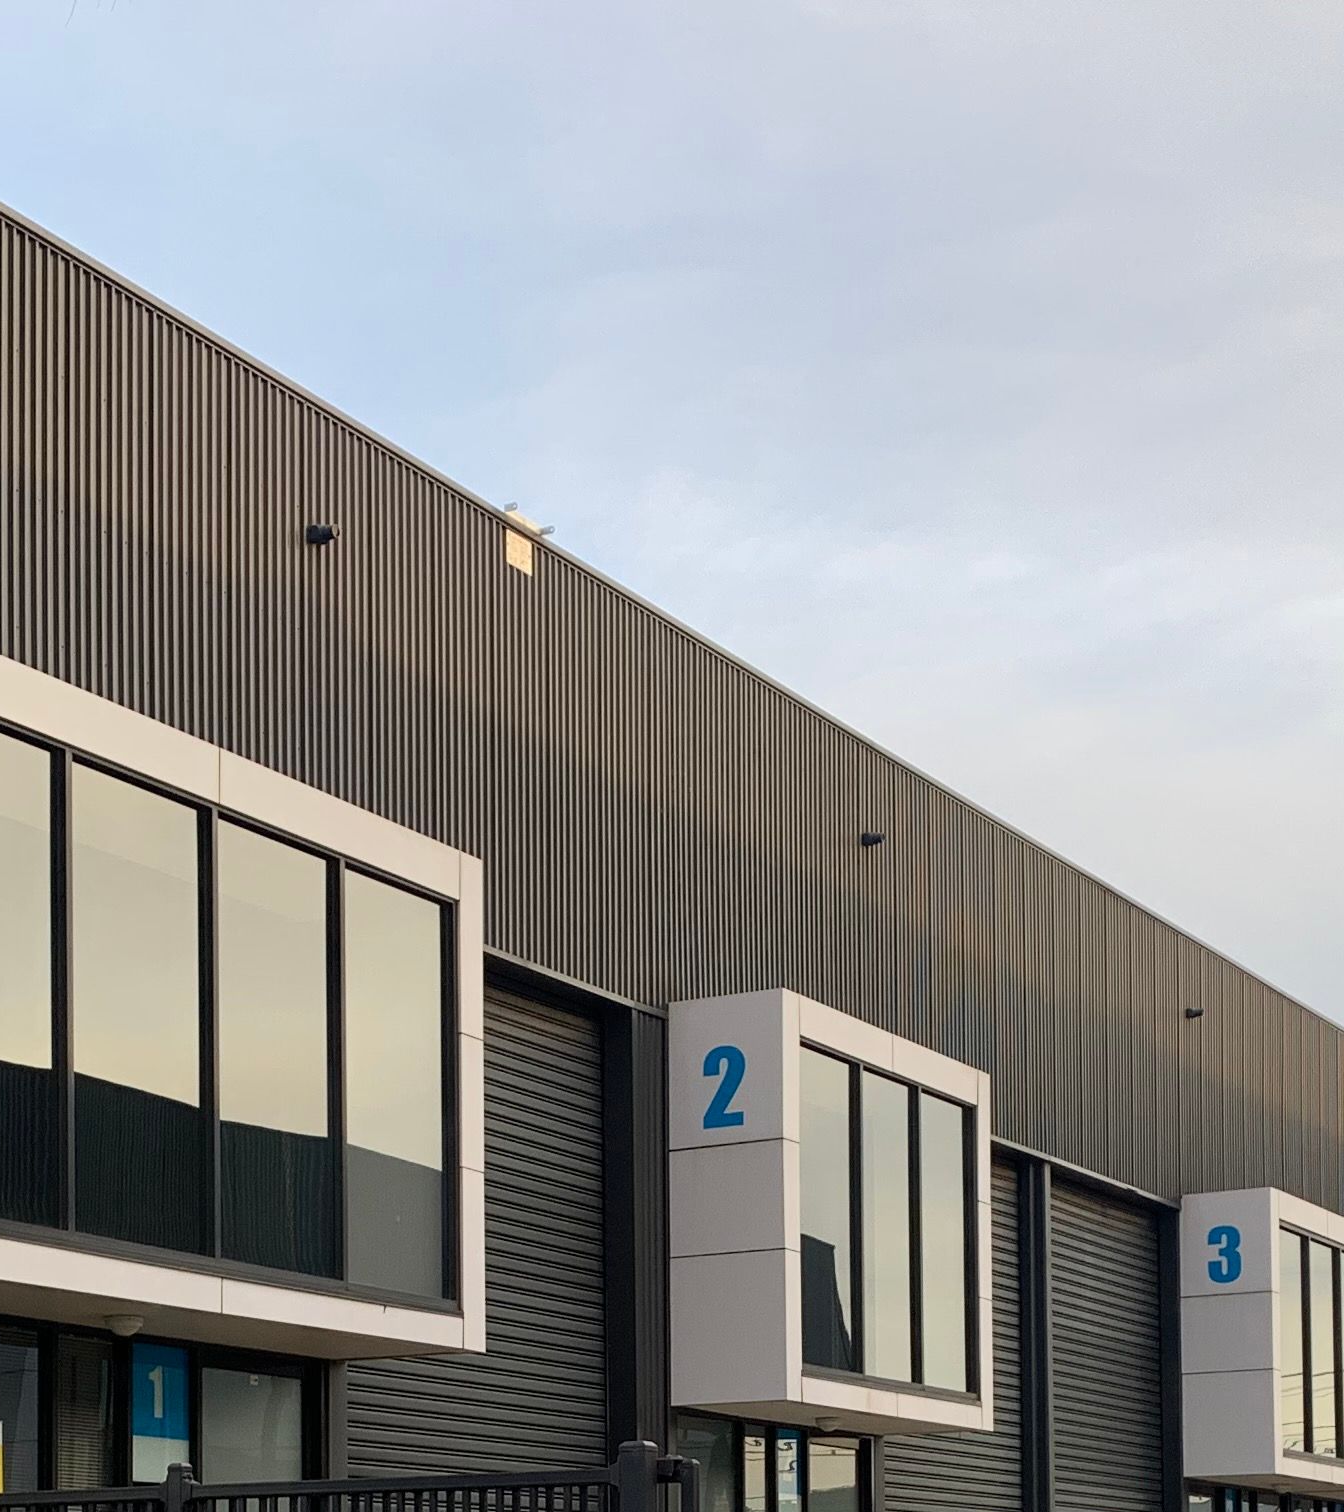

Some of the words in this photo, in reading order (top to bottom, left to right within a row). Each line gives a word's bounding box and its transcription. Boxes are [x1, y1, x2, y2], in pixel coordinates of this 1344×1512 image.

[702, 1044, 746, 1130] 2
[1207, 1225, 1242, 1284] 3
[148, 1365, 163, 1418] 1
